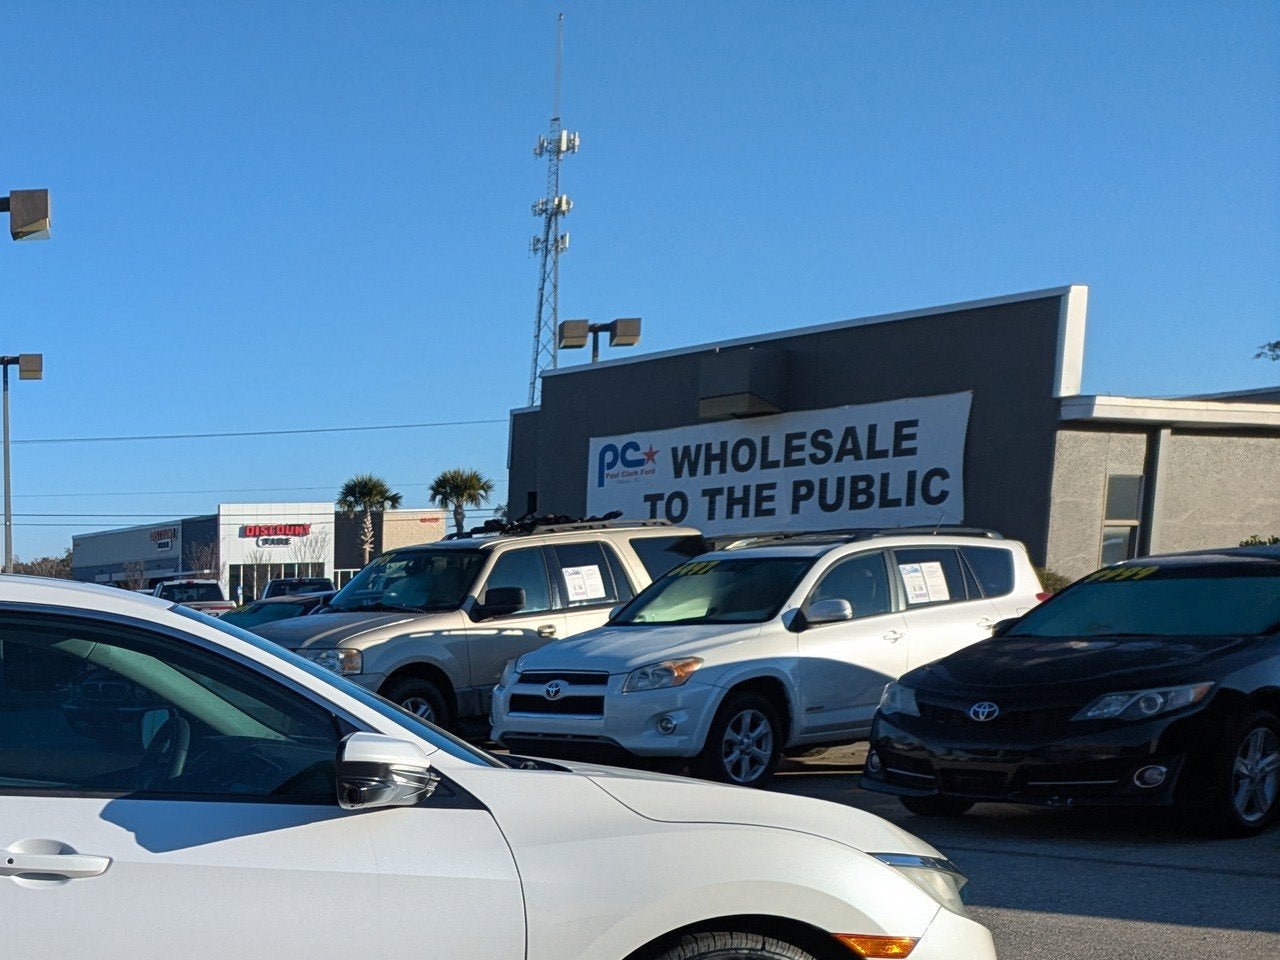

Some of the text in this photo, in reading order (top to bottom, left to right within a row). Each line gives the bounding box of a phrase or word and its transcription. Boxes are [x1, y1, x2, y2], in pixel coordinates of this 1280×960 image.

[671, 419, 920, 479] WHOLESALE
[621, 470, 638, 478] Clark
[643, 467, 951, 524] TO THE PUBLIC
[245, 523, 312, 538] DISCOUNT
[260, 537, 292, 546] TIRE
